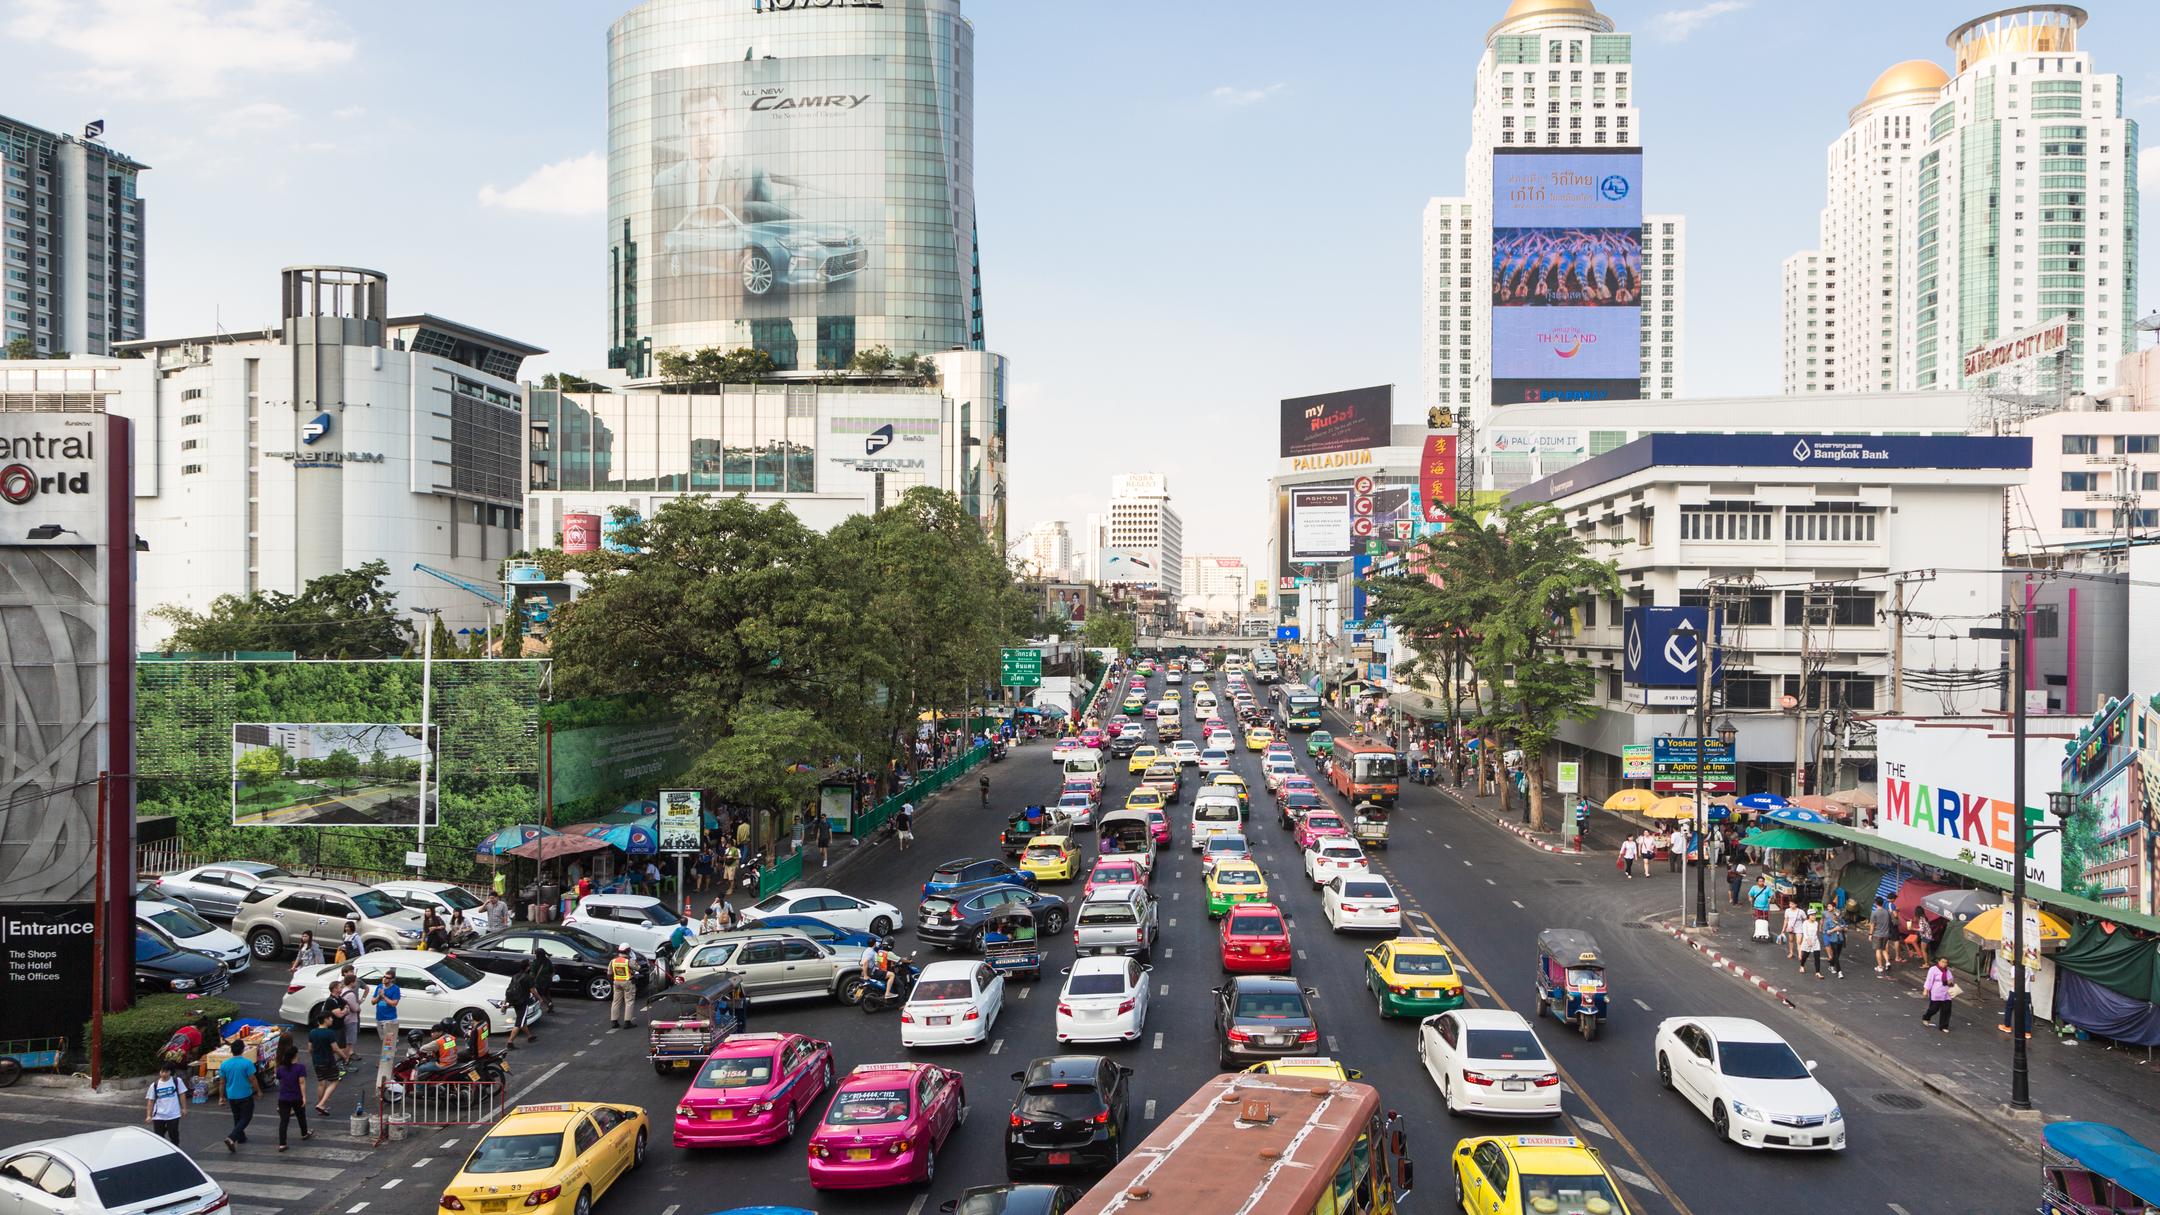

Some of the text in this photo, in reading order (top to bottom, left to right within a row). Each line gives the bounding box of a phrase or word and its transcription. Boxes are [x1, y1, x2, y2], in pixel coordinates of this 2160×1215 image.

[761, 87, 784, 95] NEW
[751, 94, 871, 111] CAMRY
[1537, 334, 1597, 343] THAILAND
[1964, 324, 2064, 378] BANGKOK CITY INN
[1305, 403, 1324, 418] my
[0, 431, 93, 459] entral
[1511, 437, 1577, 446] PALLADIUM IT
[1293, 448, 1372, 471] PALLADIUM
[1814, 450, 1889, 460] Bangkok Bank
[1886, 762, 1906, 778] THE
[1886, 777, 2044, 860] MARKET
[10, 921, 94, 936] Entrance
[10, 950, 57, 960] The Shops
[10, 961, 52, 970] The Hotel
[10, 972, 60, 981] The Offices
